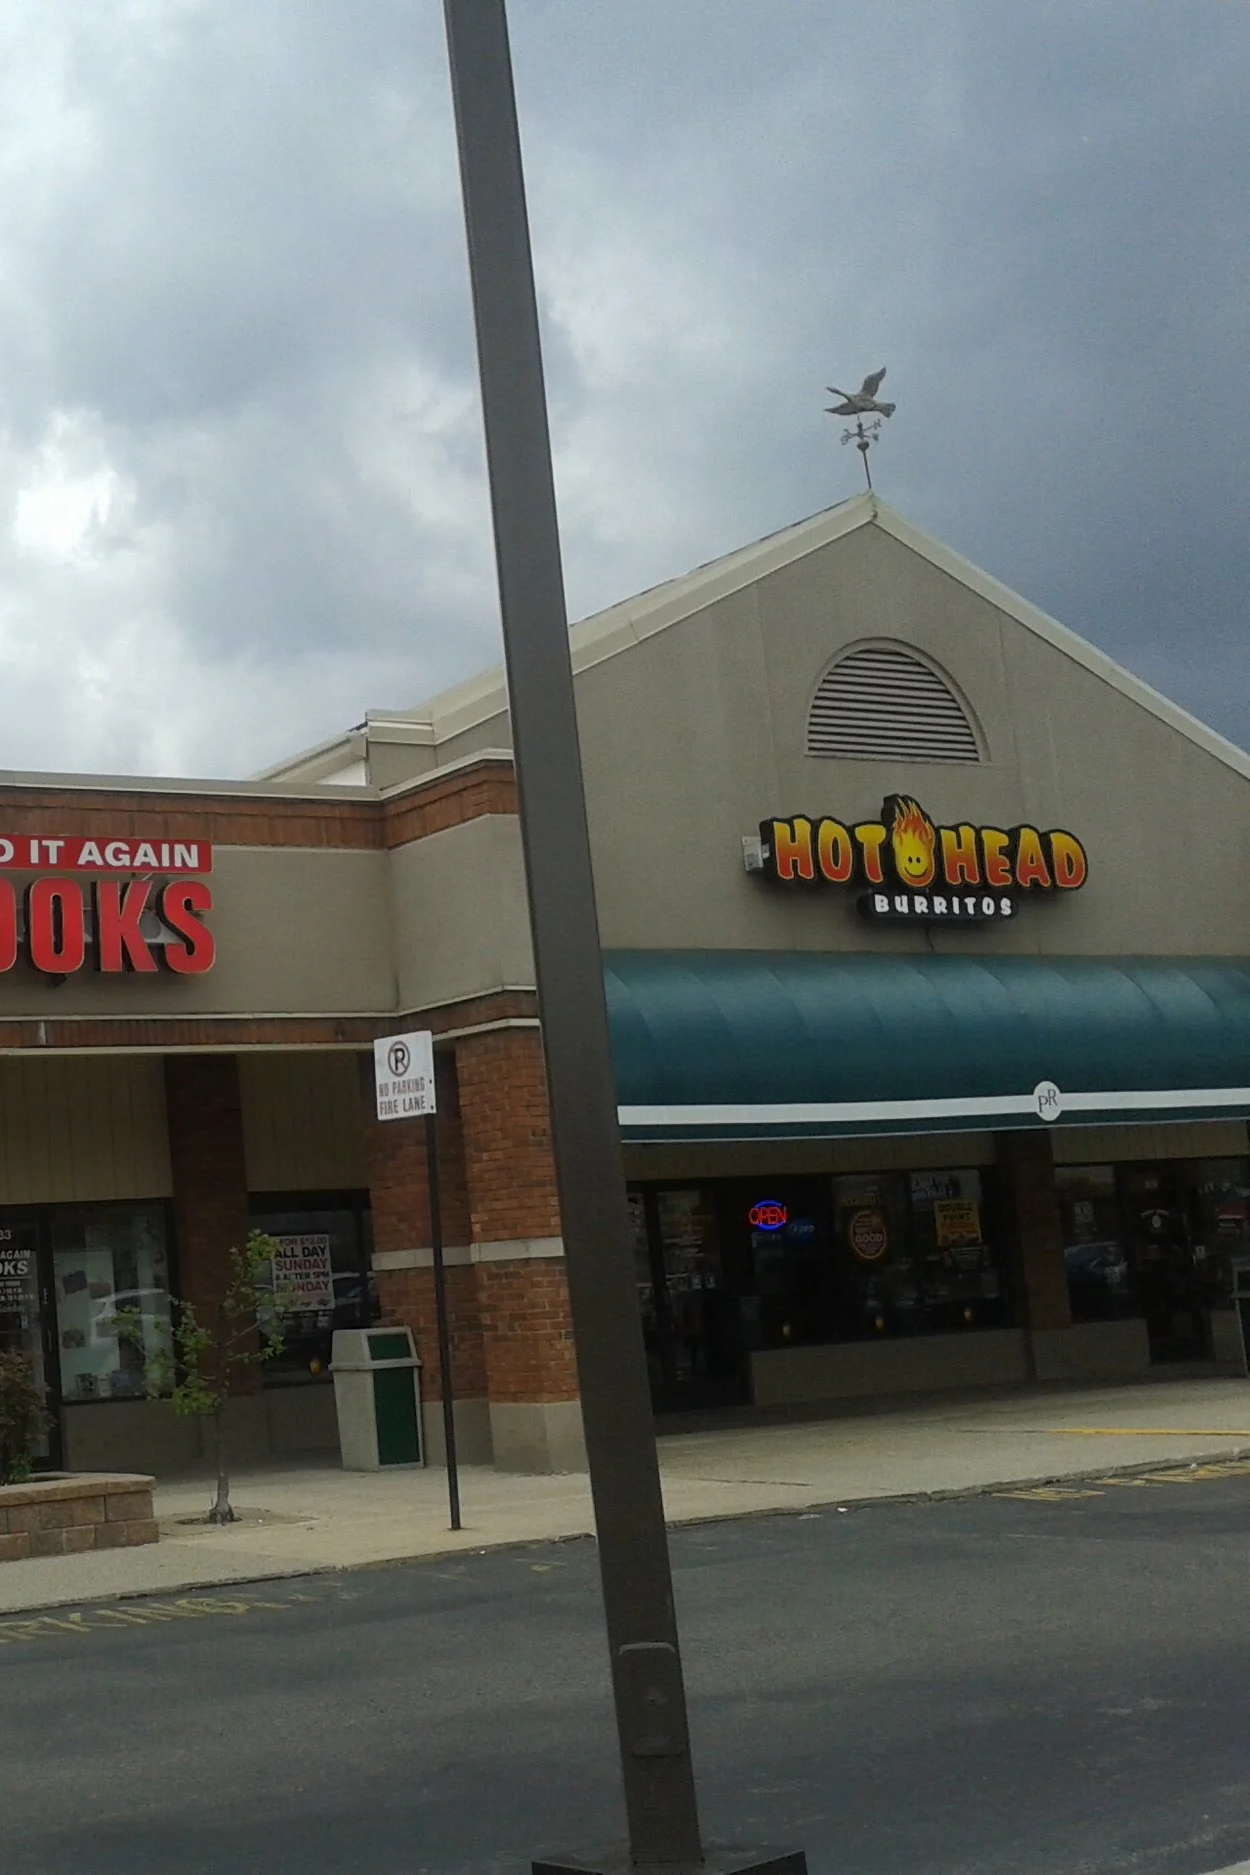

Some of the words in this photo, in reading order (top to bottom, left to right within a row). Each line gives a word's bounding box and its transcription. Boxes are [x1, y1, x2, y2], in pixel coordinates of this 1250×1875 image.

[30, 838, 65, 866] IT
[77, 840, 200, 869] AGAIN
[772, 816, 887, 886] HOT
[938, 822, 1088, 890] HEAD
[874, 893, 1013, 917] BURRITOS
[378, 1081, 389, 1097] NO
[391, 1076, 426, 1095] PARKING
[379, 1098, 400, 1116] FIRE
[402, 1095, 426, 1112] LANE
[748, 1206, 787, 1225] OPEN
[0, 1249, 31, 1260] AGAIN
[275, 1247, 298, 1258] ALL
[302, 1245, 327, 1257] DAY
[275, 1258, 327, 1271] SUNDAY
